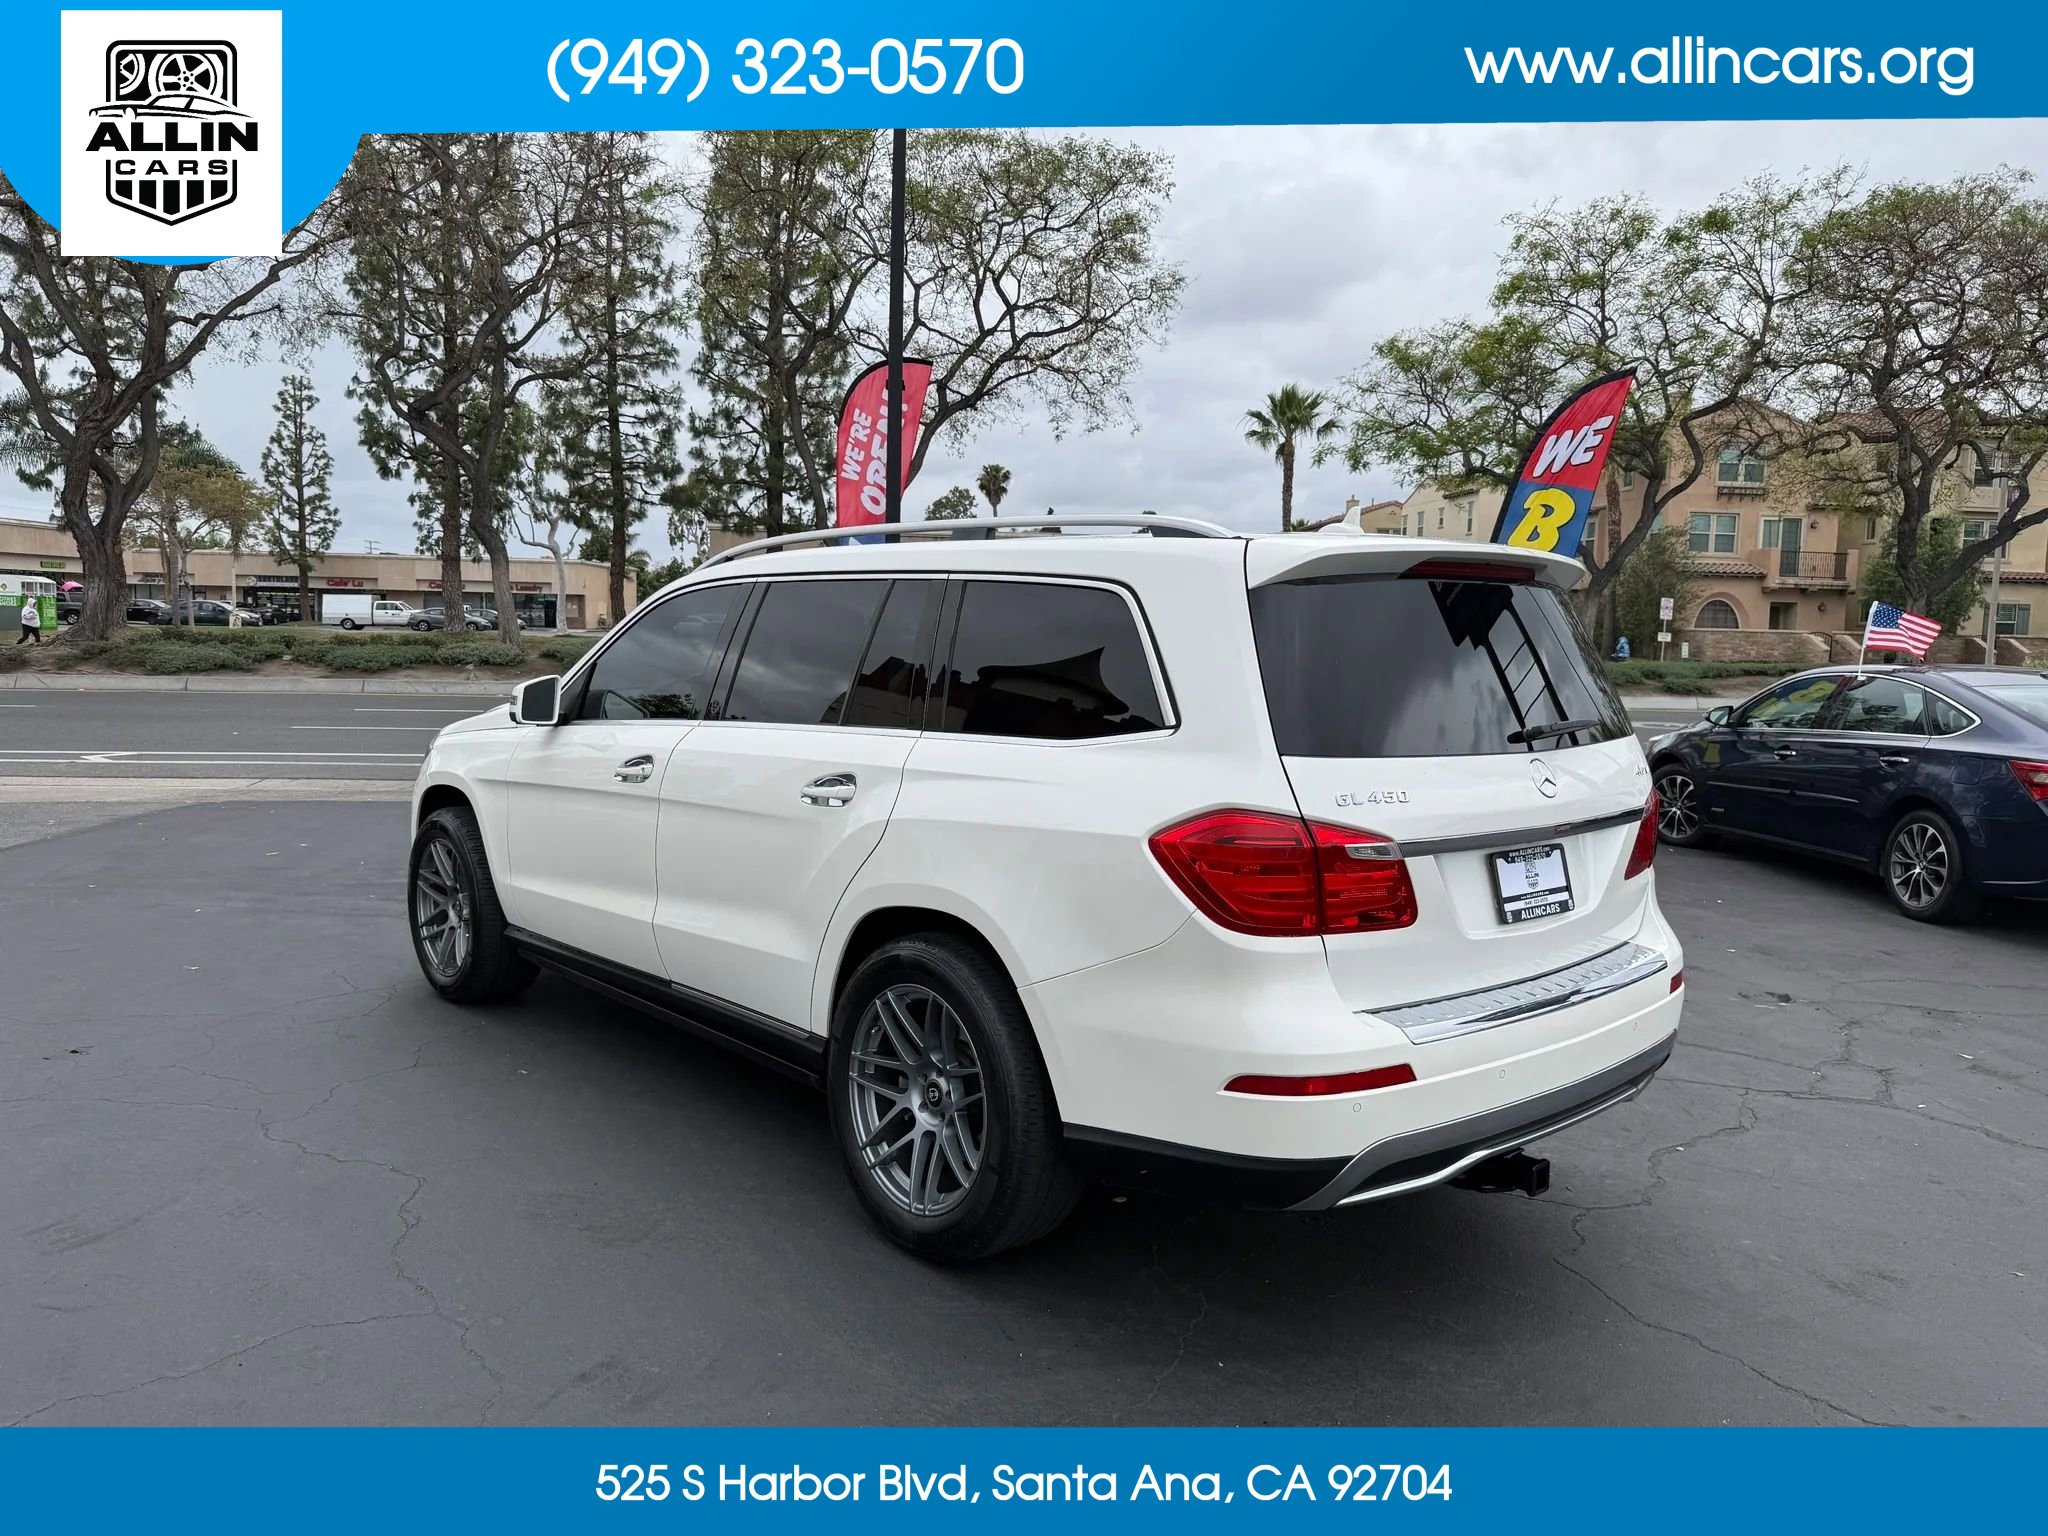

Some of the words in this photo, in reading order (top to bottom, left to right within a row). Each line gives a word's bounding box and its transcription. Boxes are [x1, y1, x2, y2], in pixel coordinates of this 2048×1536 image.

[841, 407, 872, 481] WE'RE
[1532, 415, 1614, 478] WE
[1507, 487, 1576, 552] B
[1335, 792, 1364, 807] GL
[1367, 790, 1411, 804] 450
[1521, 904, 1560, 919] ALLINCARS
